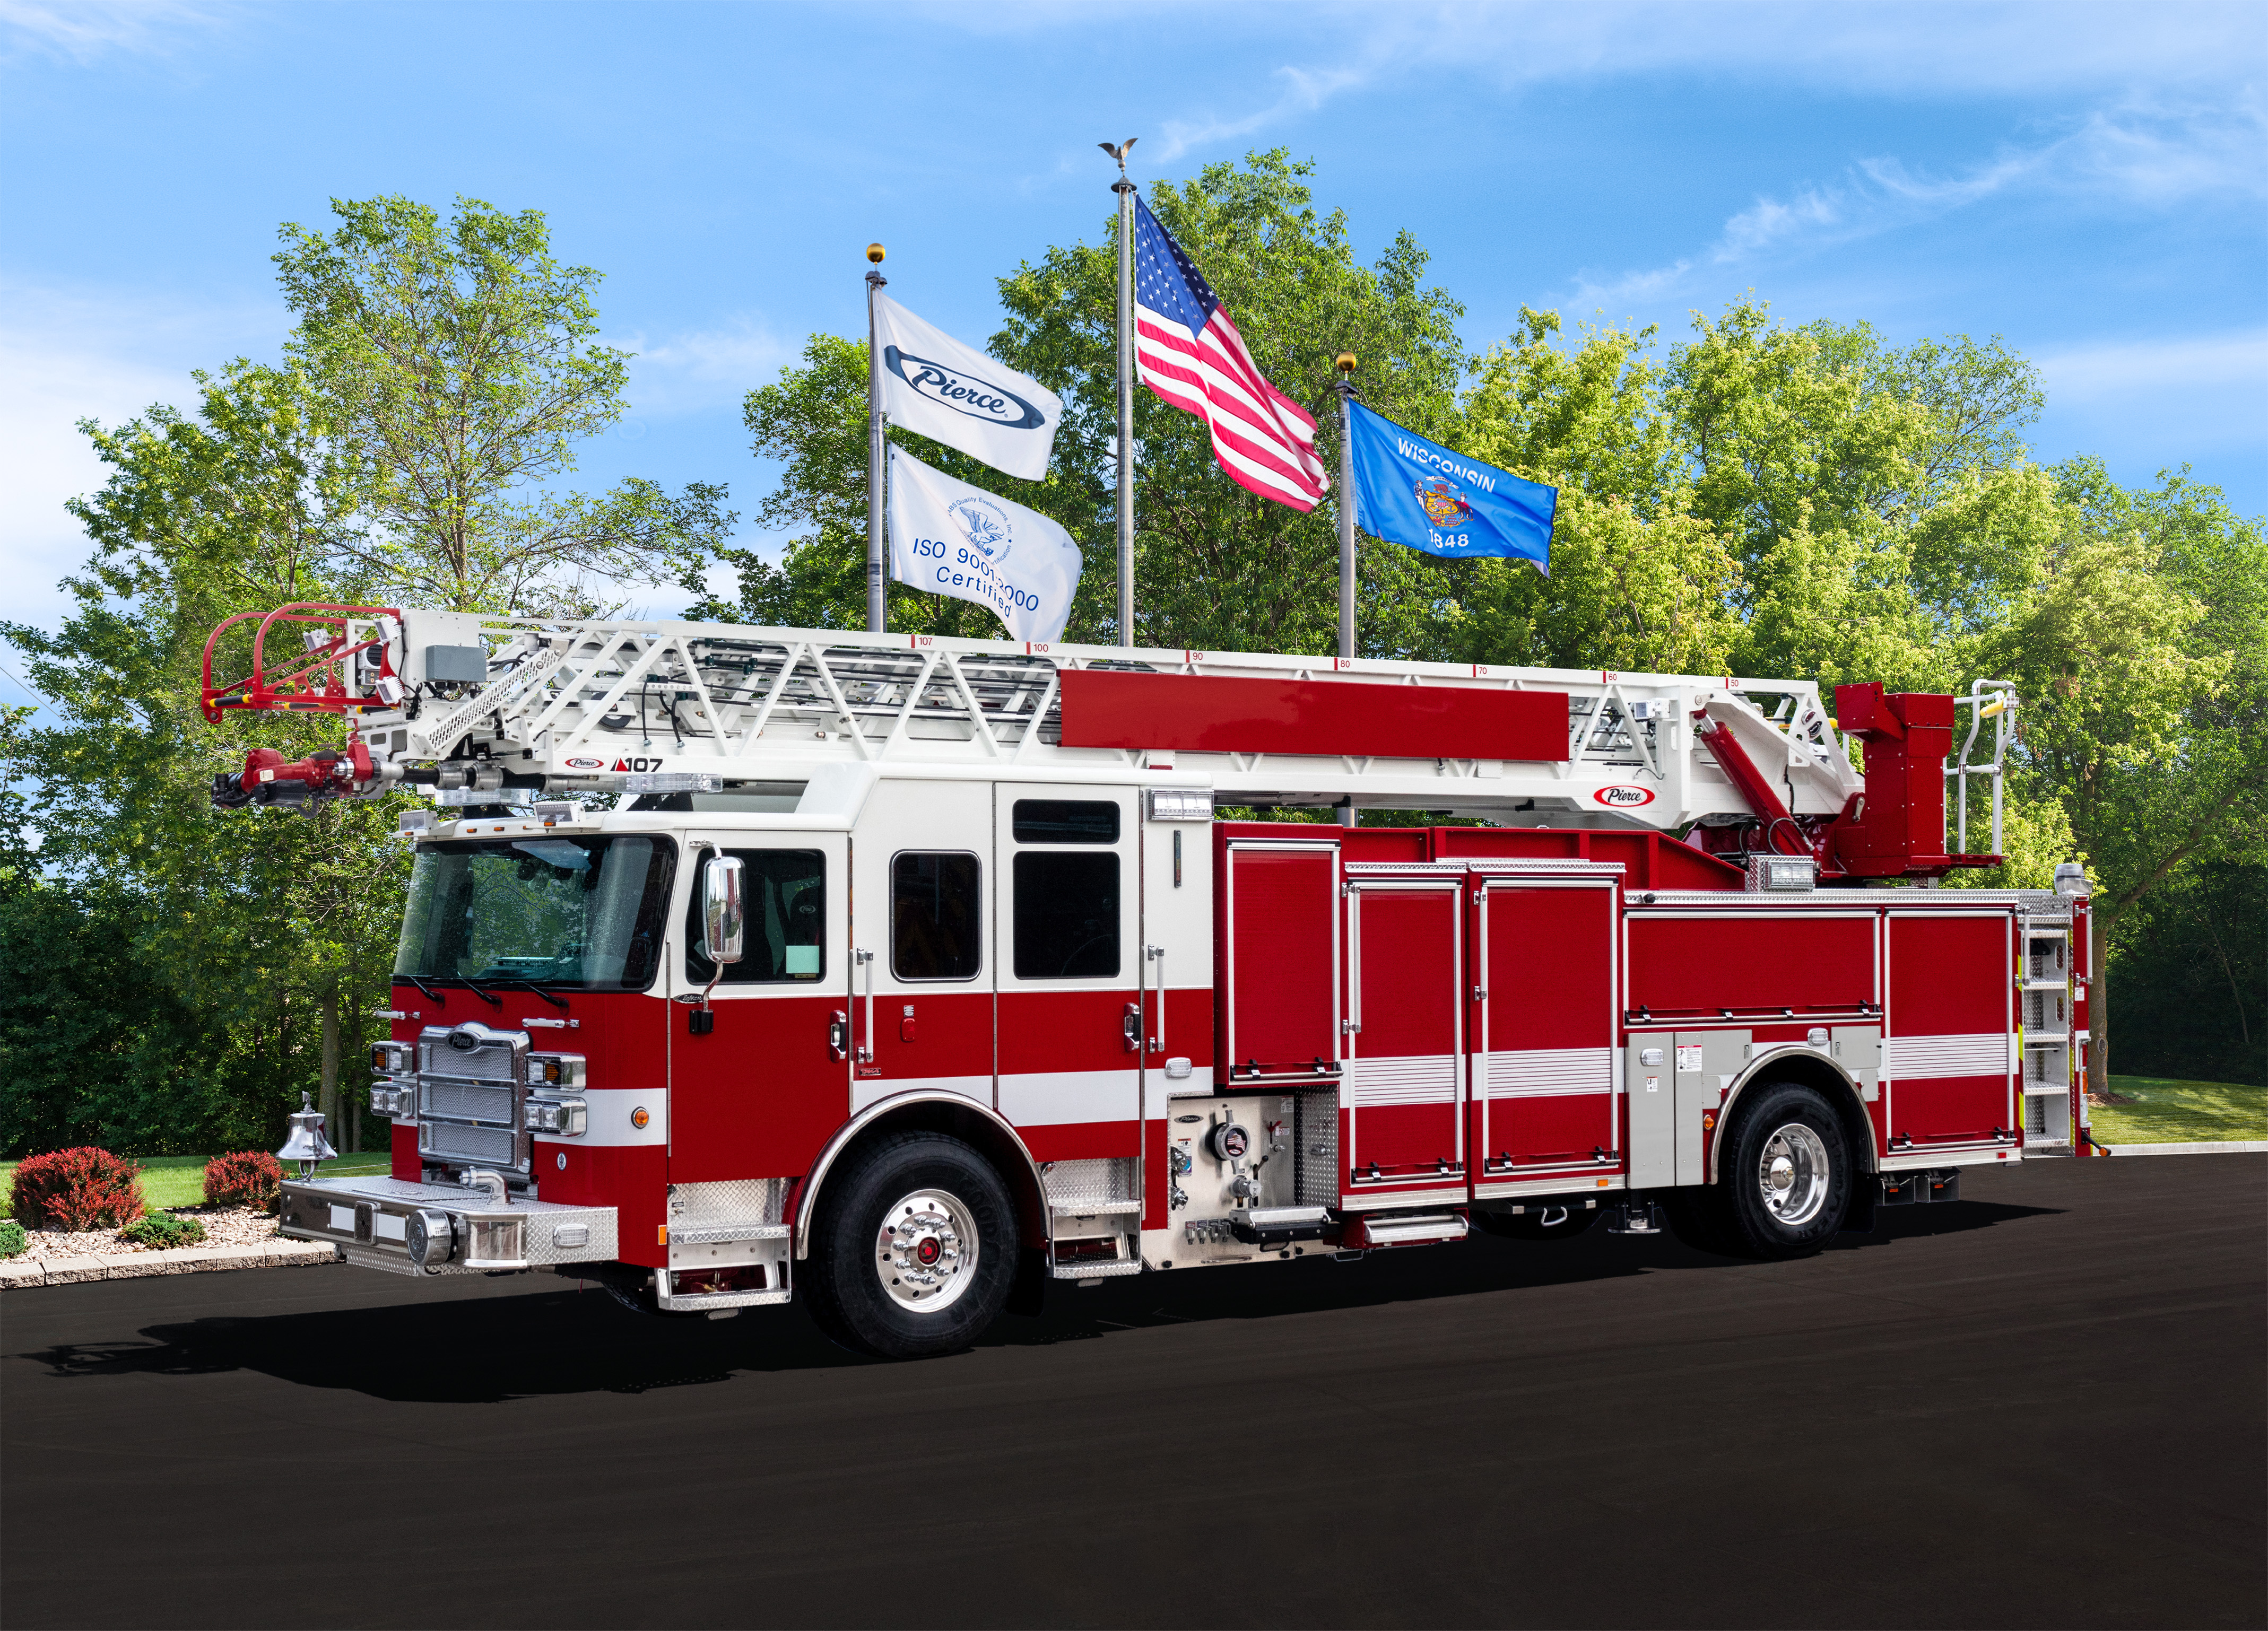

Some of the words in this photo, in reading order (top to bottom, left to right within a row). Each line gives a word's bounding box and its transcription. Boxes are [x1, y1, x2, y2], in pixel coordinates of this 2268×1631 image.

[911, 365, 1007, 414] Pierce
[1398, 437, 1496, 493] WISCONSIN
[948, 502, 957, 513] ABS
[956, 496, 977, 505] Quality
[978, 497, 1009, 523] Evaluations,
[1428, 528, 1469, 548] 1848
[913, 538, 946, 559] ISO
[957, 548, 1039, 611] 9001:2000
[936, 566, 1011, 618] Certified
[918, 637, 933, 646] 107
[1033, 644, 1049, 652] 100
[1607, 788, 1641, 803] Pierce
[452, 1034, 471, 1047] Pierce
